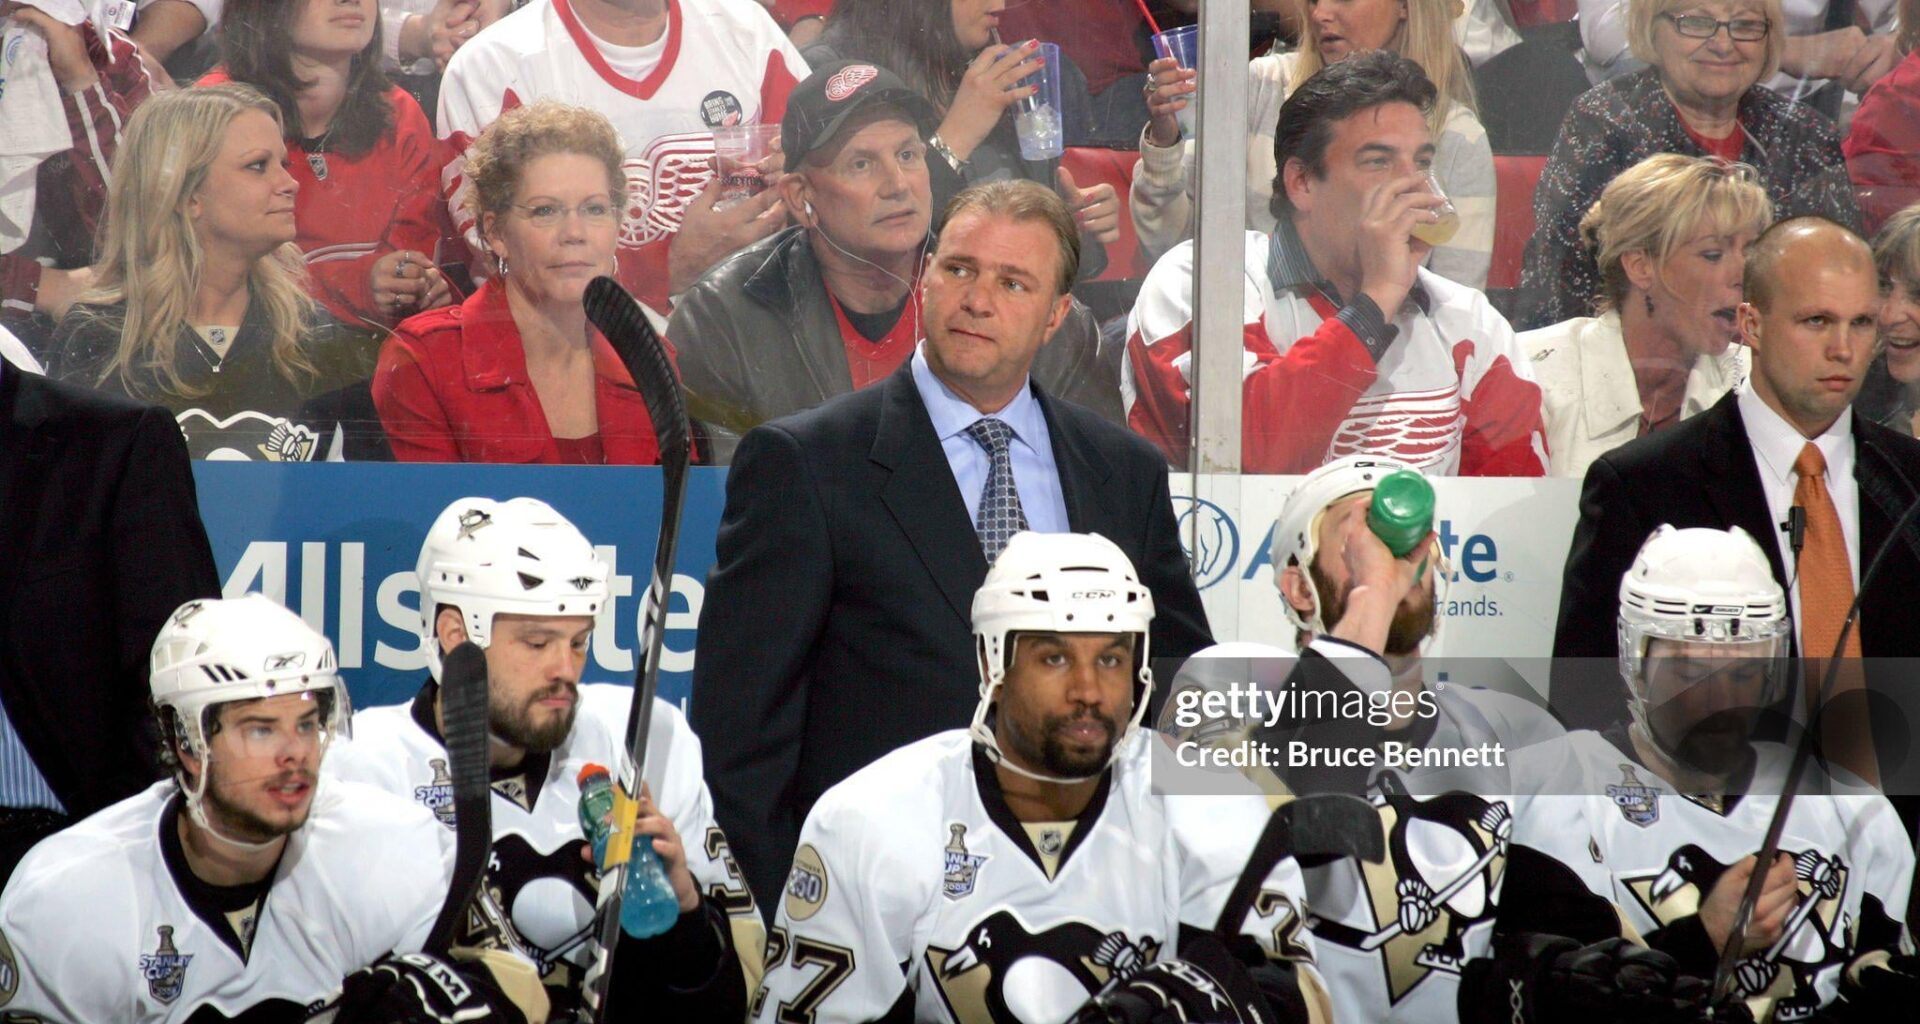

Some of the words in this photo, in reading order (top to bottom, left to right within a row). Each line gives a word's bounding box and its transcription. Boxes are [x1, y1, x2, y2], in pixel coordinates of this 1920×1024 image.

[1071, 591, 1112, 600] CCM
[222, 541, 705, 673] Allste
[1613, 795, 1645, 807] CUP
